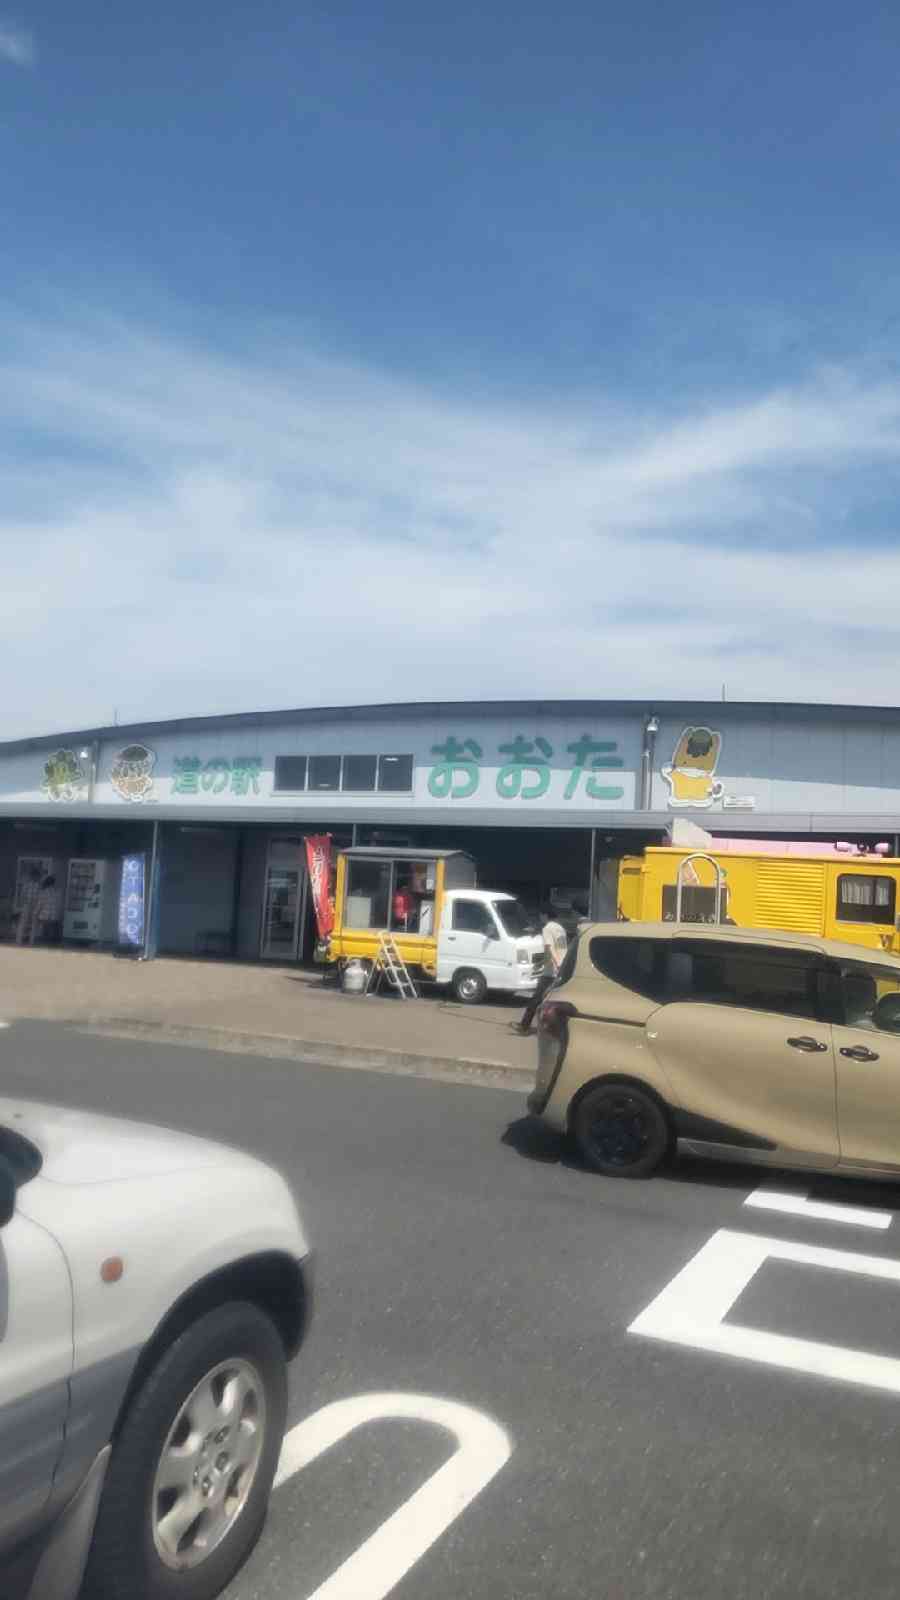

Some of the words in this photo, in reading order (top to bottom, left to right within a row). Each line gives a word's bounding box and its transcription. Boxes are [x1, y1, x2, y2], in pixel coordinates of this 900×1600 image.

[171, 755, 262, 795] 道の駅
[429, 736, 622, 800] おおた
